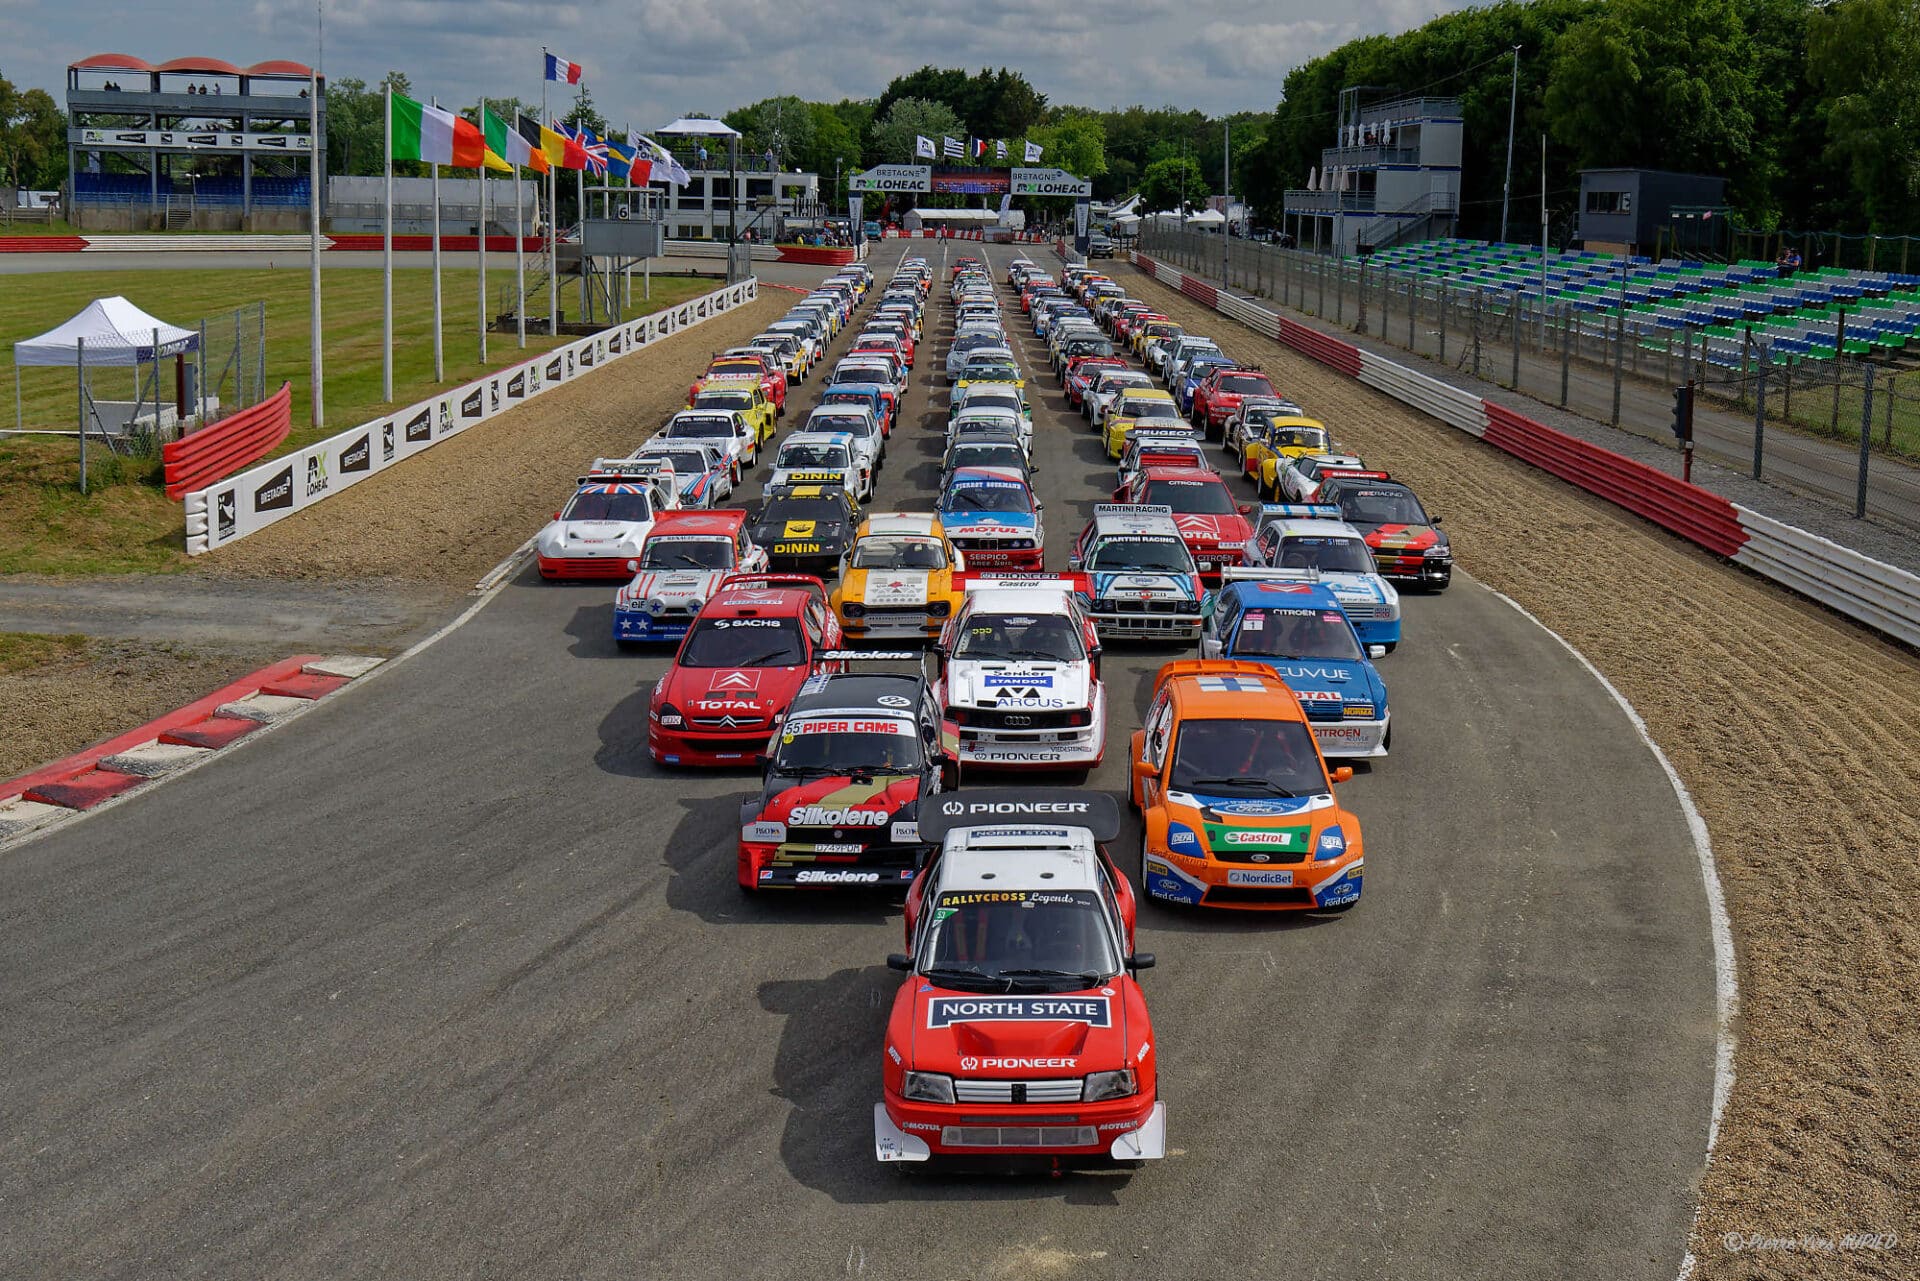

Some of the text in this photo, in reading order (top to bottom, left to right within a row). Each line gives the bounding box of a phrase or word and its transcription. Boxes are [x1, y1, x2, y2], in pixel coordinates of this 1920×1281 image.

[877, 169, 921, 177] BRETAGNE
[1012, 173, 1057, 181] BRETAGNE
[620, 207, 628, 218] 6
[306, 476, 329, 498] LOHEAC
[958, 526, 1019, 534] MOTUL
[1182, 531, 1221, 540] OTAL
[732, 619, 781, 627] SACHS
[822, 650, 913, 660] Silkolene
[696, 700, 761, 710] TOTAL
[995, 698, 1063, 708] ARCUS
[785, 721, 898, 735] 55 PIPER CAMS
[990, 752, 1061, 761] PIONEER
[969, 802, 1087, 814] PIONEER
[788, 807, 889, 826] Silkolene
[1240, 832, 1284, 843] Castrol
[795, 871, 880, 883] Silkolene
[1242, 872, 1292, 884] NordicBet
[942, 892, 1026, 906] RALLYCROSS
[1030, 892, 1074, 904] Legends
[942, 1001, 1099, 1017] NORTH STATE
[982, 1058, 1077, 1069] PIONEER
[908, 1122, 942, 1131] MOTUL
[1099, 1121, 1131, 1130] MOTUL
